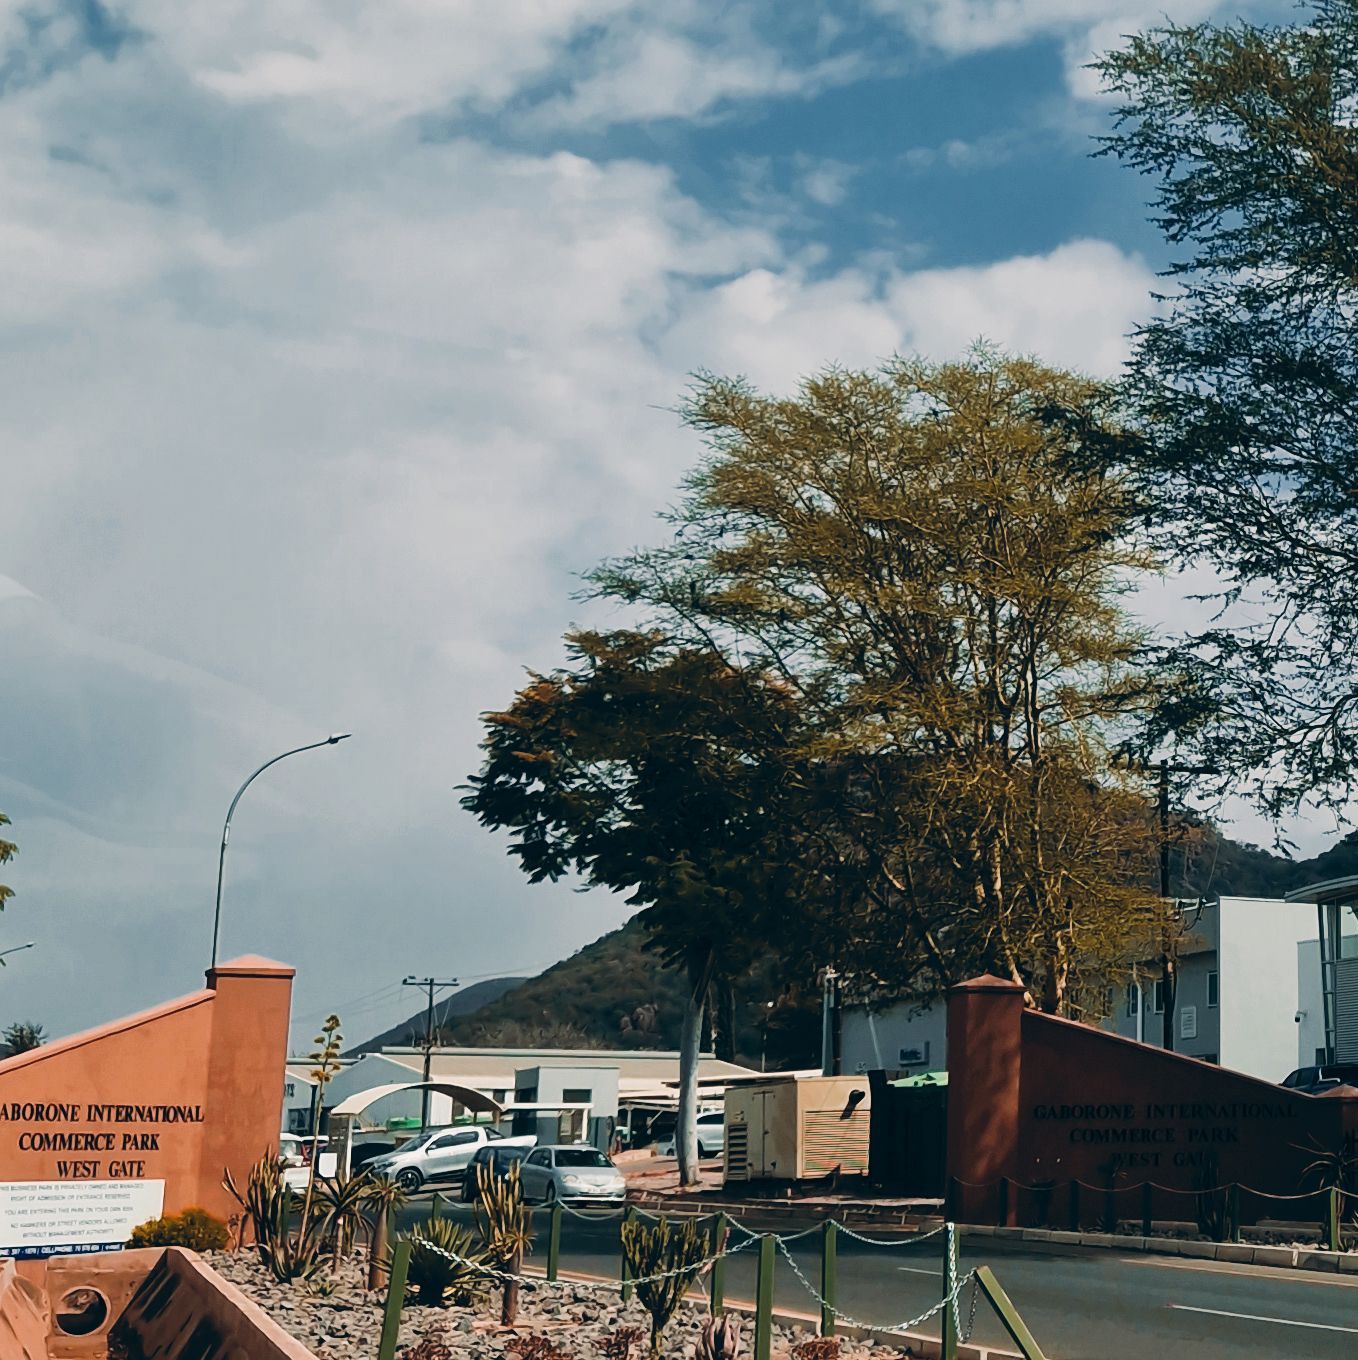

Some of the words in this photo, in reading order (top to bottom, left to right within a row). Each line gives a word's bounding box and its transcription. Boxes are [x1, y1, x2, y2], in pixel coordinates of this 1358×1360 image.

[0, 1103, 80, 1122] ABORONE
[87, 1104, 204, 1123] INTERNATIONAL
[1034, 1104, 1134, 1120] GABORONE
[1146, 1103, 1297, 1119] INTERNATIONAL
[18, 1133, 116, 1151] COMMERCE
[121, 1133, 160, 1151] PARK
[1069, 1128, 1175, 1144] COMMERCE
[1187, 1127, 1239, 1143] PARK
[56, 1160, 100, 1178] WEST
[109, 1160, 146, 1178] GATE
